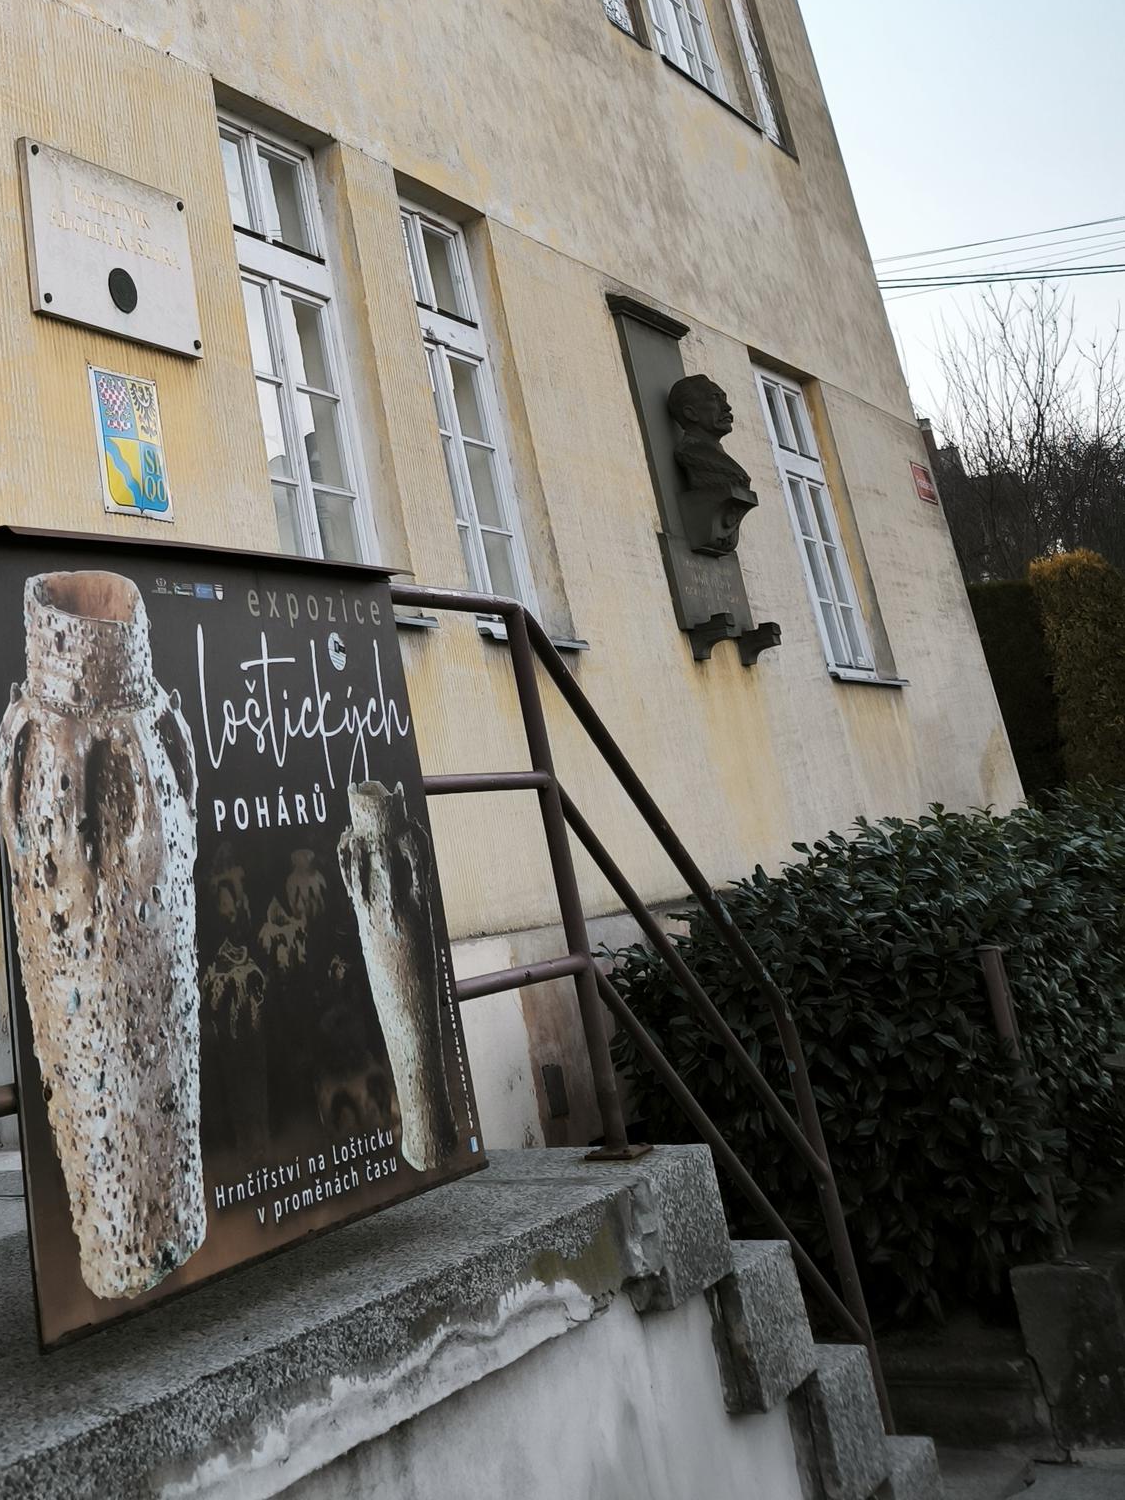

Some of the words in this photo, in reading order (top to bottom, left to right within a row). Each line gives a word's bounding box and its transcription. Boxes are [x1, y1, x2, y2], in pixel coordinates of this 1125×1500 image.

[247, 588, 382, 628] expozice
[213, 782, 328, 833] POHÁRŮ
[216, 1156, 300, 1209] Hrnčířství
[308, 1153, 326, 1180] na
[332, 1127, 395, 1166] Lošticku
[257, 1204, 266, 1225] v
[273, 1168, 360, 1225] proměnách
[366, 1155, 398, 1182] času
